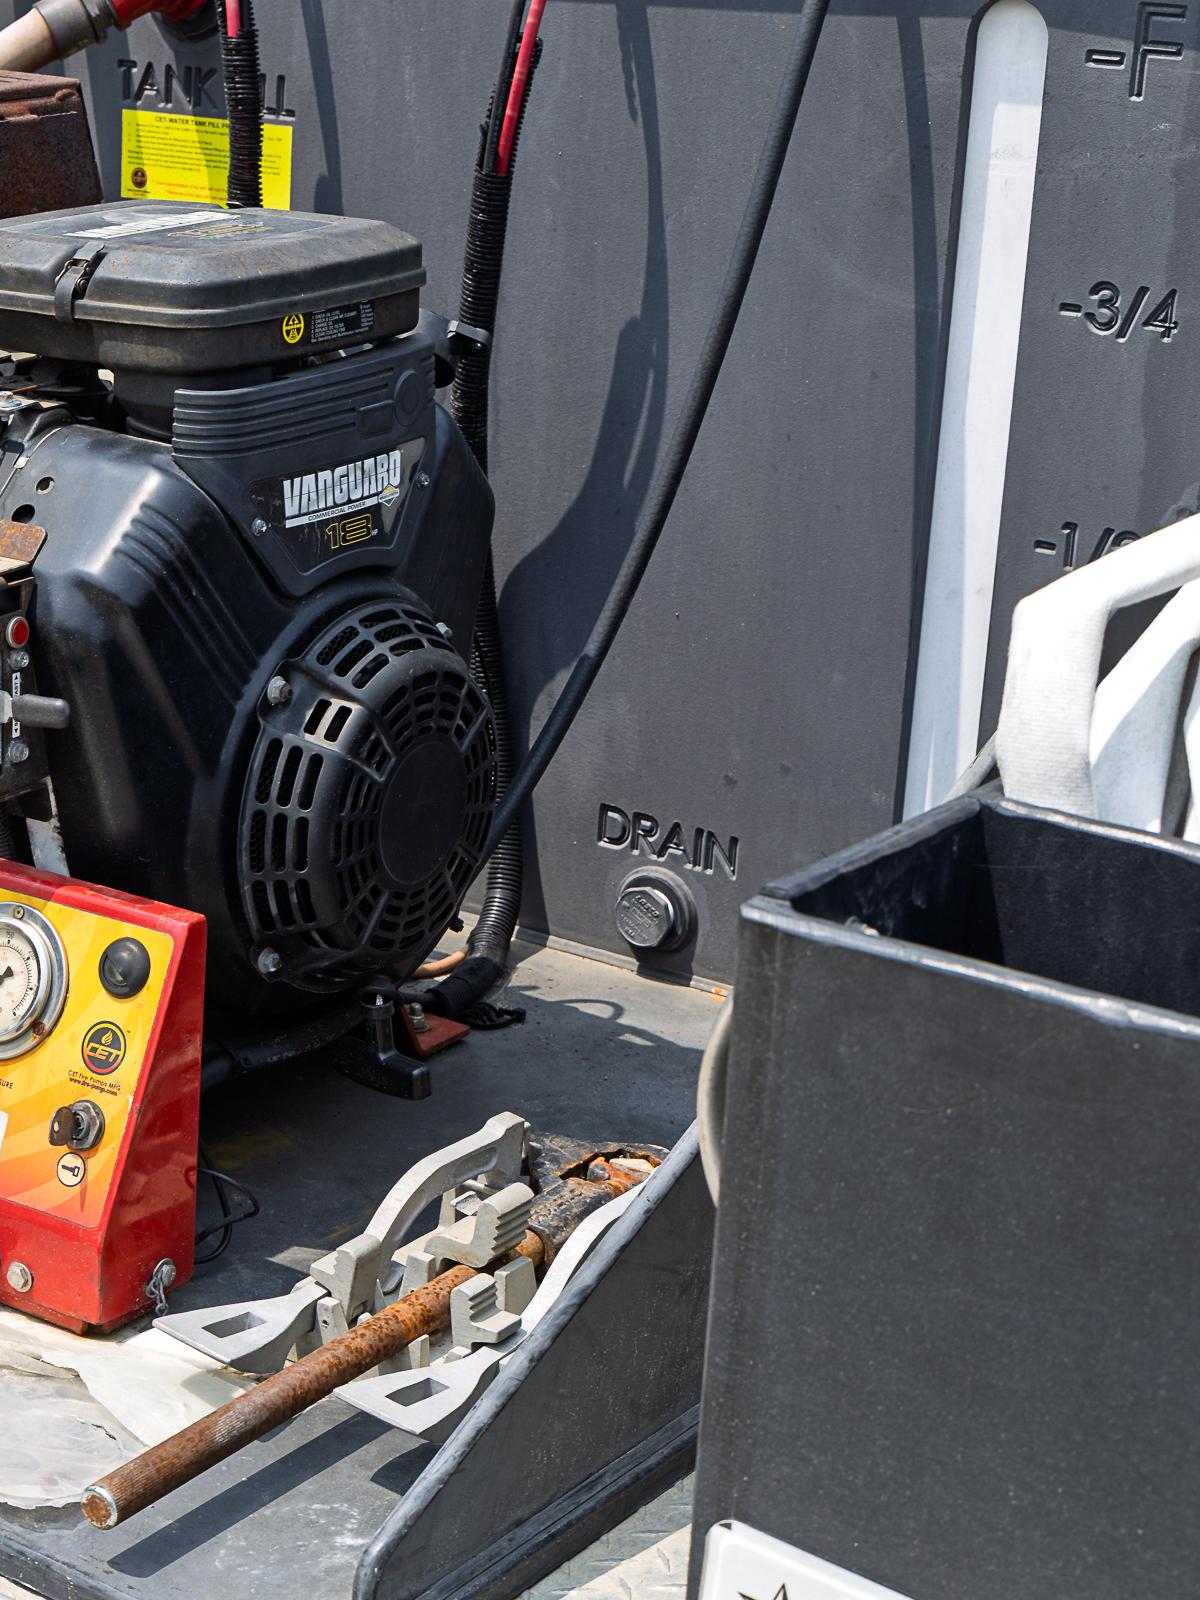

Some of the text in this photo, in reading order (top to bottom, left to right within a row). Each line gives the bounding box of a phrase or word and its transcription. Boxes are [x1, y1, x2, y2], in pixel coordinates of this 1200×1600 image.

[117, 59, 218, 111] TANK
[169, 117, 191, 125] WATER
[191, 119, 208, 127] TANK
[208, 121, 220, 129] FILL
[283, 449, 400, 518] VANGUARD
[308, 500, 366, 521] COMMERCIAL POWER
[326, 513, 372, 549] 18
[597, 802, 740, 881] DRAIN
[86, 1042, 121, 1063] CET
[78, 1071, 89, 1080] Fire
[89, 1076, 108, 1087] Pumps
[108, 1082, 121, 1092] MFG
